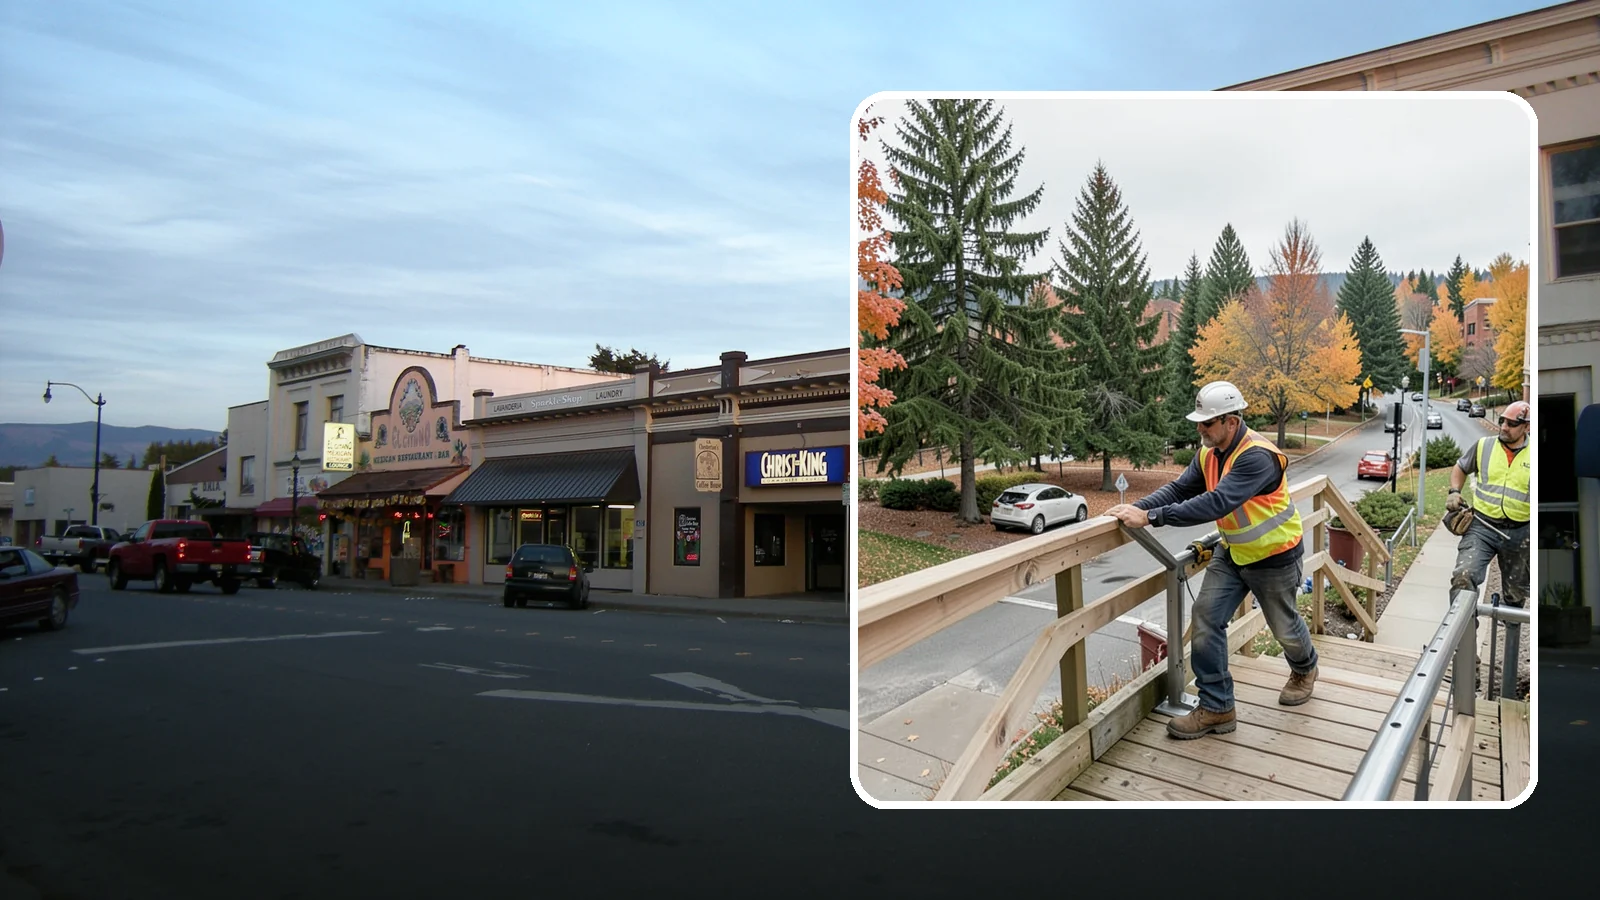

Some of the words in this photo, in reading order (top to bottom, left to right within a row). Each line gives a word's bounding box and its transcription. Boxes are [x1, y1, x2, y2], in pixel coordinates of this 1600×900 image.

[596, 389, 623, 400] LAUNDRY
[493, 402, 522, 412] LAVANDERIA
[531, 397, 561, 408] Sparkle
[562, 394, 582, 405] Shop
[374, 454, 396, 464] MEXICAN
[397, 451, 433, 462] RESTAURANT
[437, 450, 450, 459] BAR
[761, 452, 797, 477] CHRIST
[800, 450, 827, 476] KING
[696, 481, 709, 489] Coffee
[710, 481, 722, 489] House
